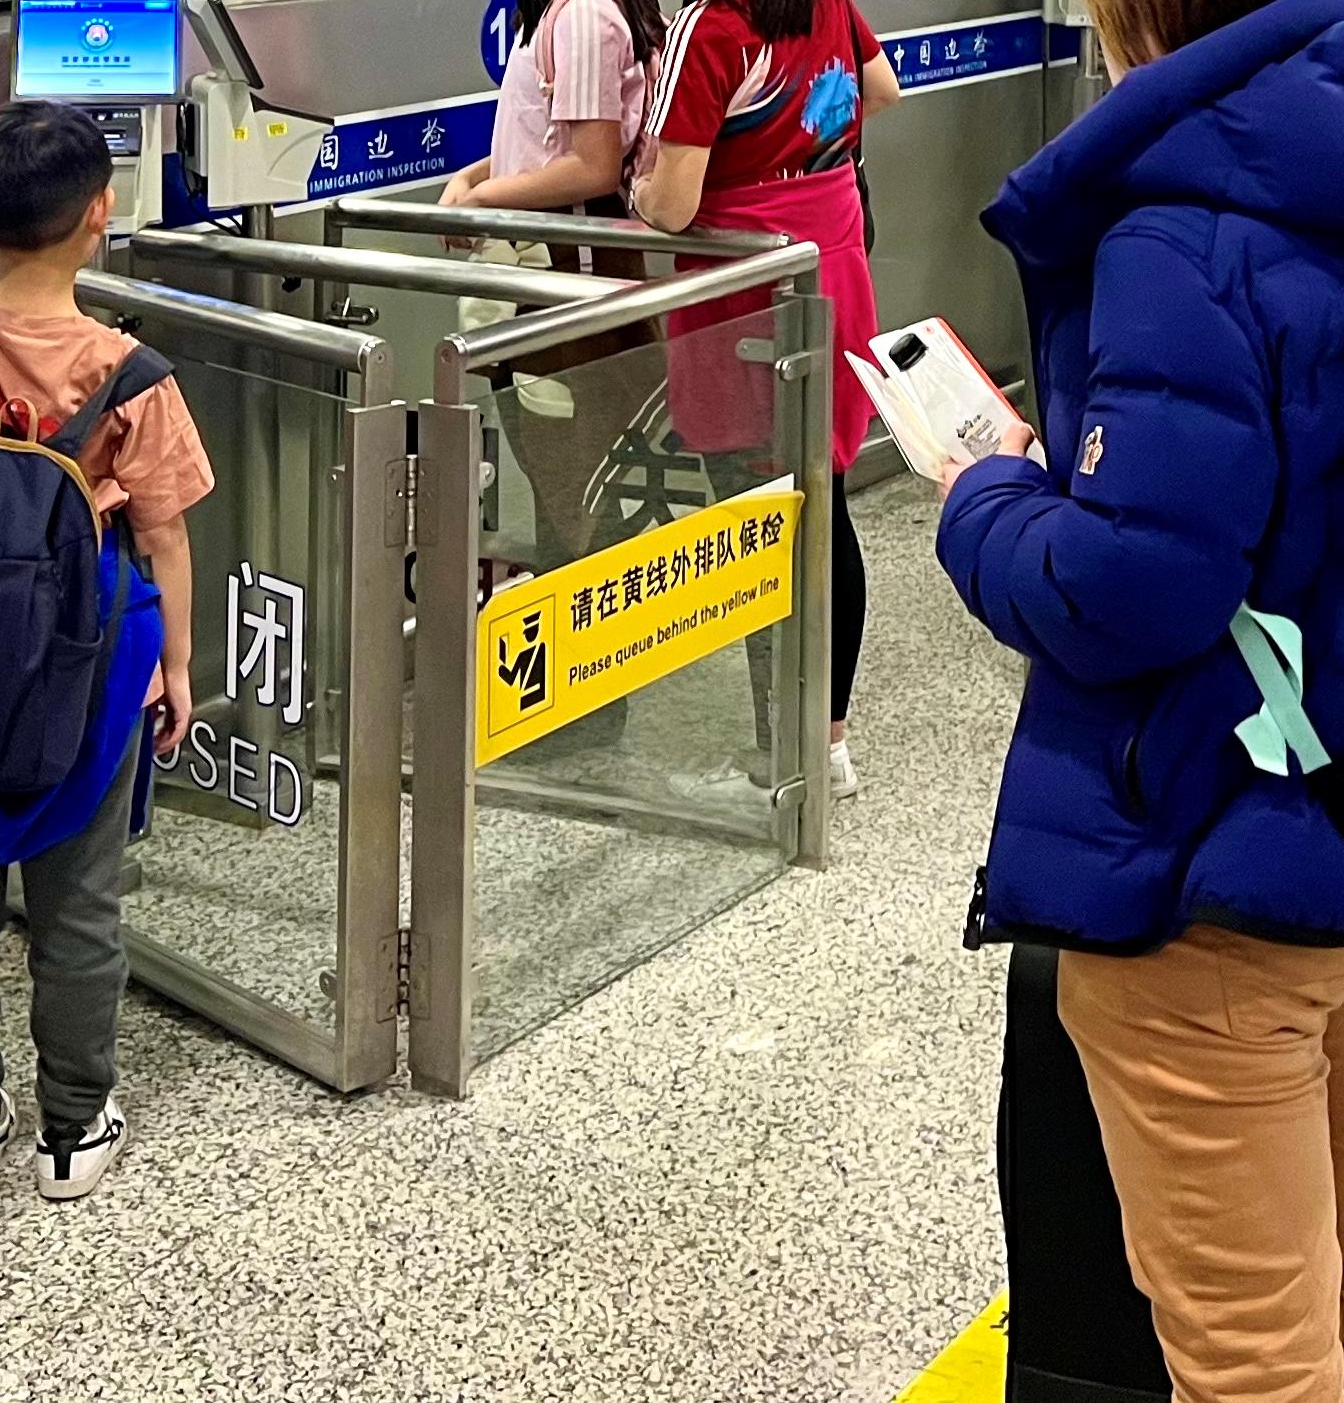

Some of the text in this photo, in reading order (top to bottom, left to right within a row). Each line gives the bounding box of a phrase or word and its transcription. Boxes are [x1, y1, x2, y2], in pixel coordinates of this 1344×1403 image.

[309, 157, 445, 194] IMMIGRATION INSPECTION
[320, 117, 446, 171] 国边检
[570, 511, 785, 633] 请在黄线外排队候检
[225, 561, 305, 724] 闭
[569, 576, 779, 686] Please queue behind the yellow line
